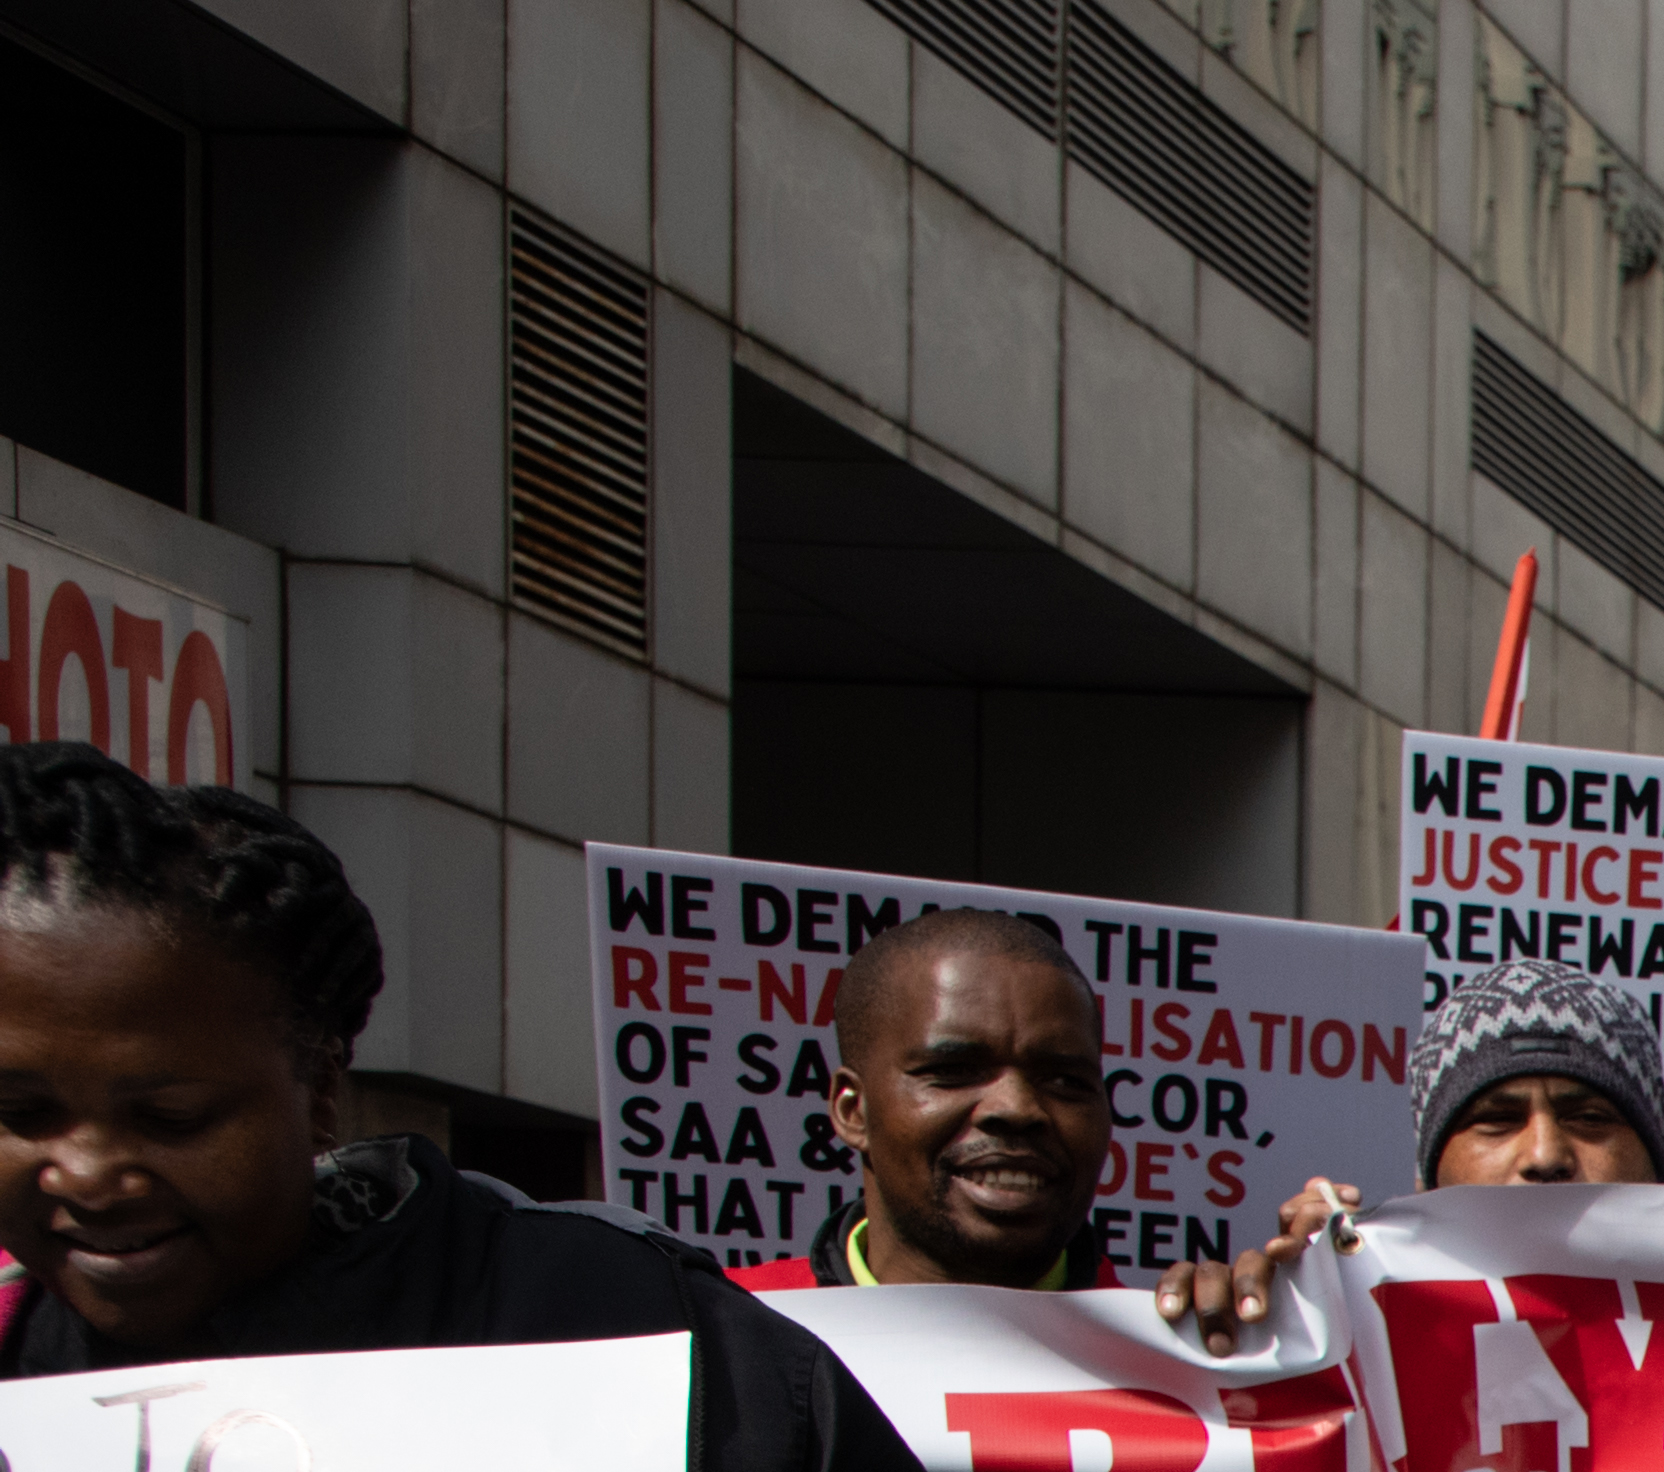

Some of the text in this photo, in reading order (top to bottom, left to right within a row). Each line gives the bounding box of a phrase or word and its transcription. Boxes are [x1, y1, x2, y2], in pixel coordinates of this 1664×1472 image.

[1412, 752, 1503, 822] WE
[606, 867, 717, 941] WE
[1086, 920, 1219, 993] THE
[615, 1021, 710, 1088] OF
[1104, 1069, 1275, 1148] COR,
[619, 1095, 775, 1169] SAA
[800, 1114, 856, 1174] &
[618, 1168, 804, 1240] THAT
[1093, 1208, 1230, 1268] EEN
